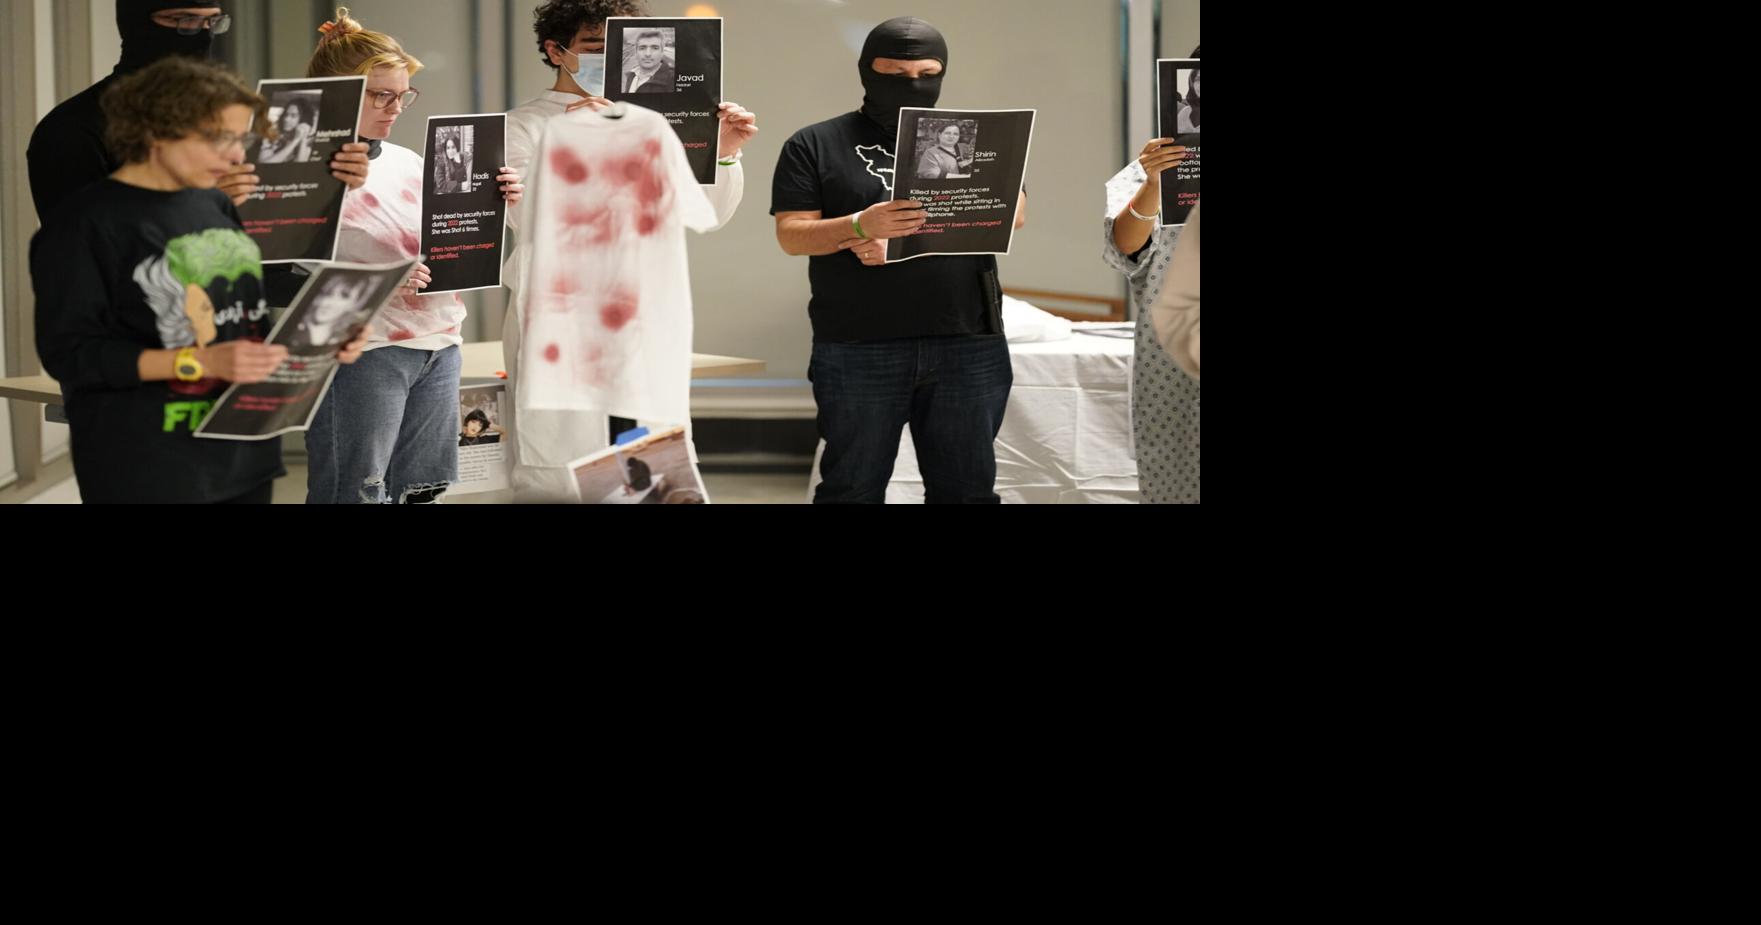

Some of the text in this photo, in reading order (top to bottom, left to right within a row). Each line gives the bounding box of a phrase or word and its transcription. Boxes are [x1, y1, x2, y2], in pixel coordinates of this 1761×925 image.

[677, 74, 703, 82] Javad
[975, 150, 997, 158] Shirin
[472, 172, 489, 180] Hadis
[941, 187, 968, 195] security
[973, 197, 993, 205] sitting
[443, 212, 457, 220] dead
[447, 219, 459, 227] 2022
[971, 219, 1002, 227] charged
